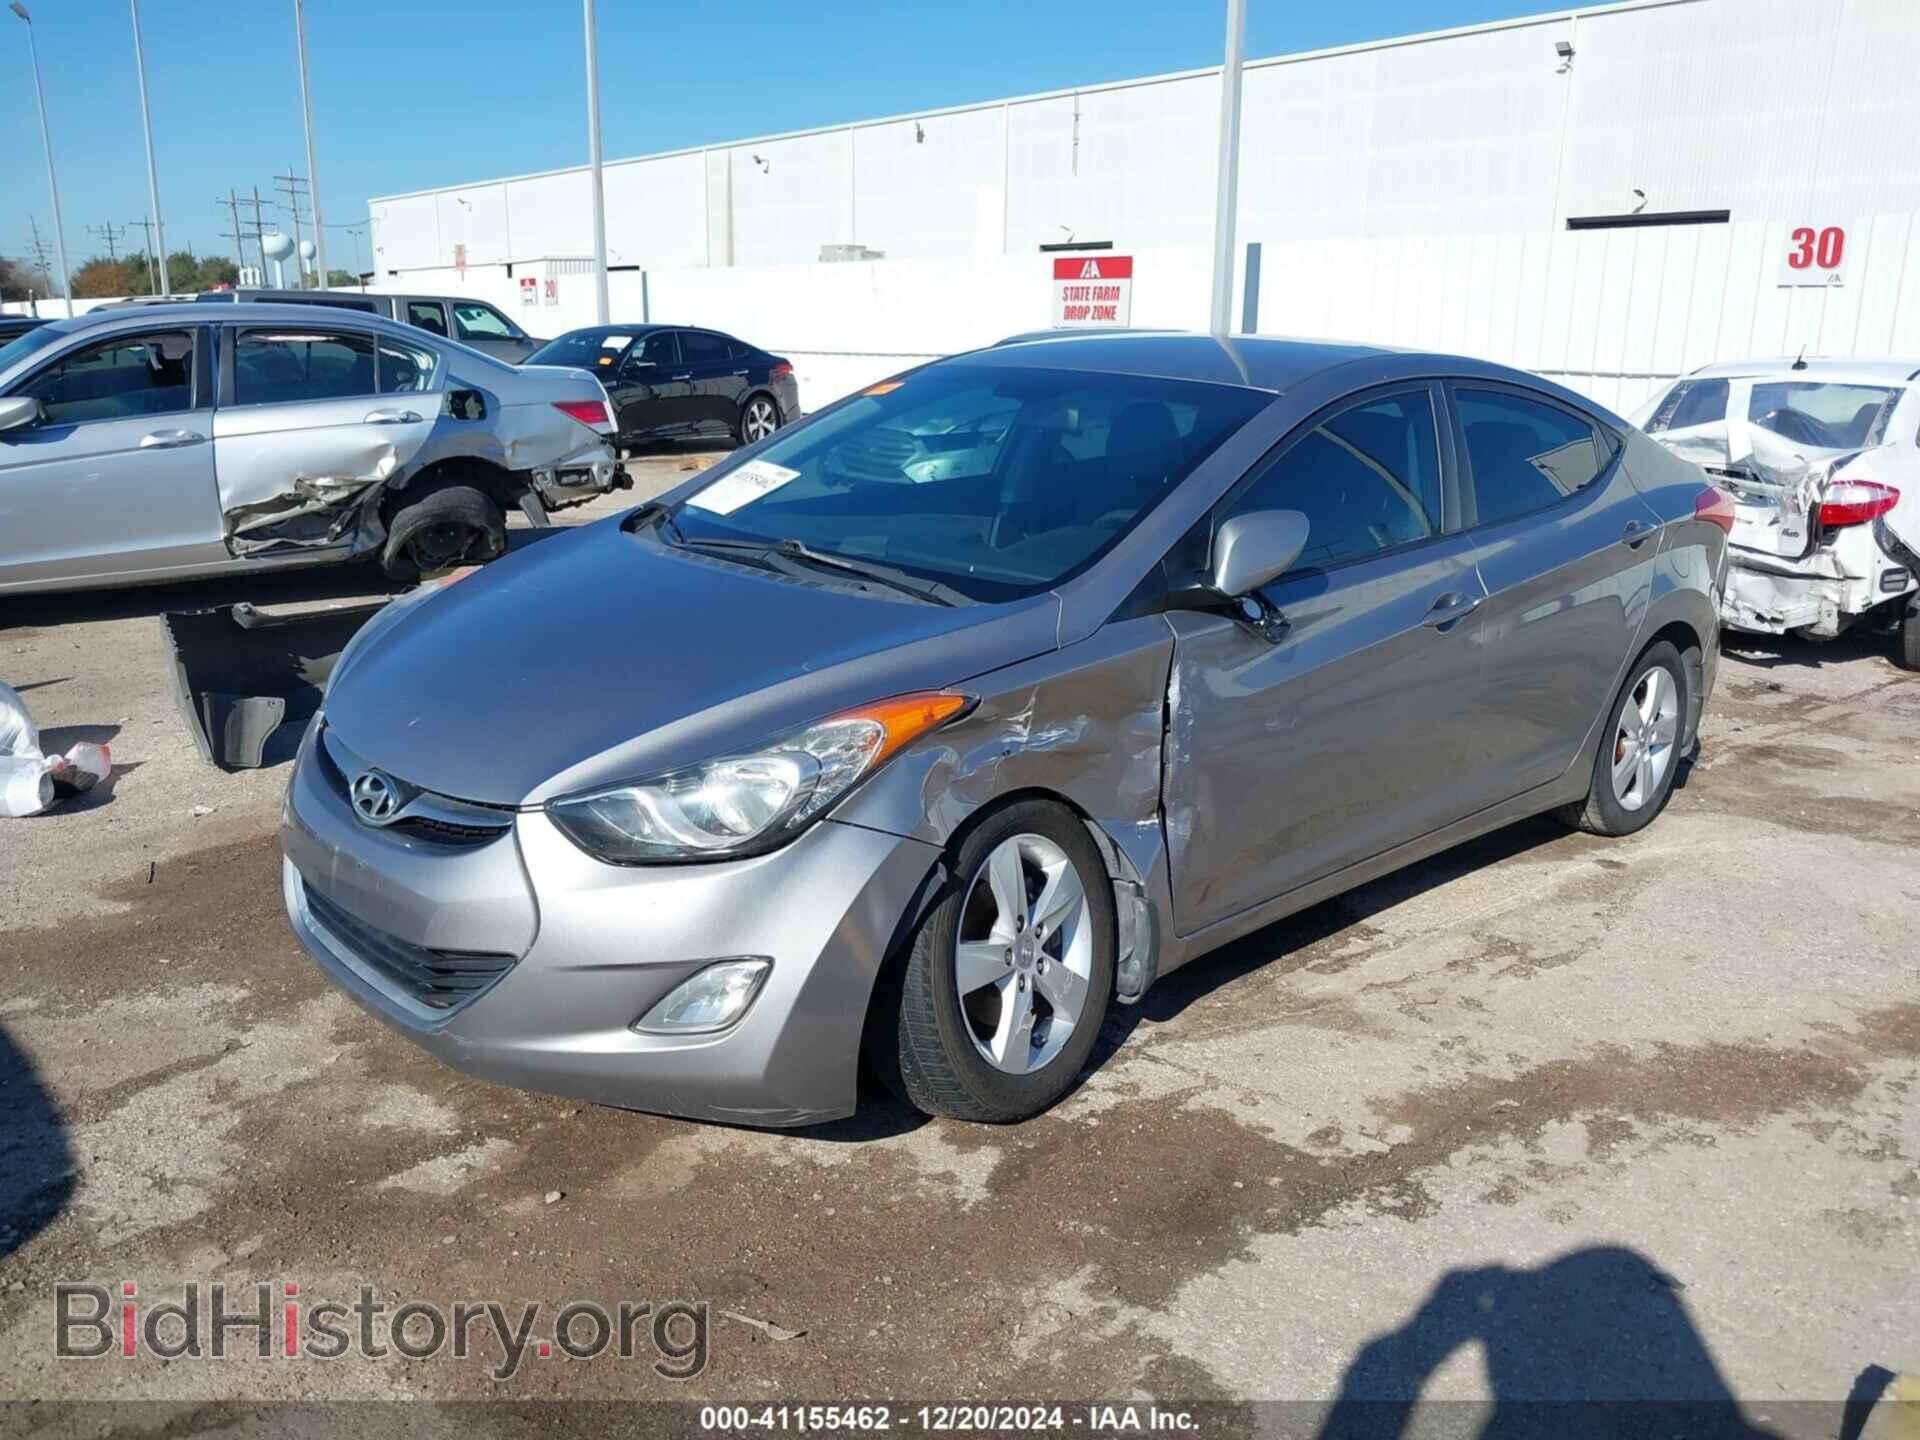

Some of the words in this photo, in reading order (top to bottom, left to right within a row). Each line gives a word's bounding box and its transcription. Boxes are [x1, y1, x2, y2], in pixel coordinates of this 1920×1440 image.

[1788, 226, 1844, 269] 30
[1062, 286, 1091, 302] STATE
[1092, 285, 1121, 301] FARM
[1063, 305, 1091, 321] DROP
[1092, 305, 1117, 321] ZONE
